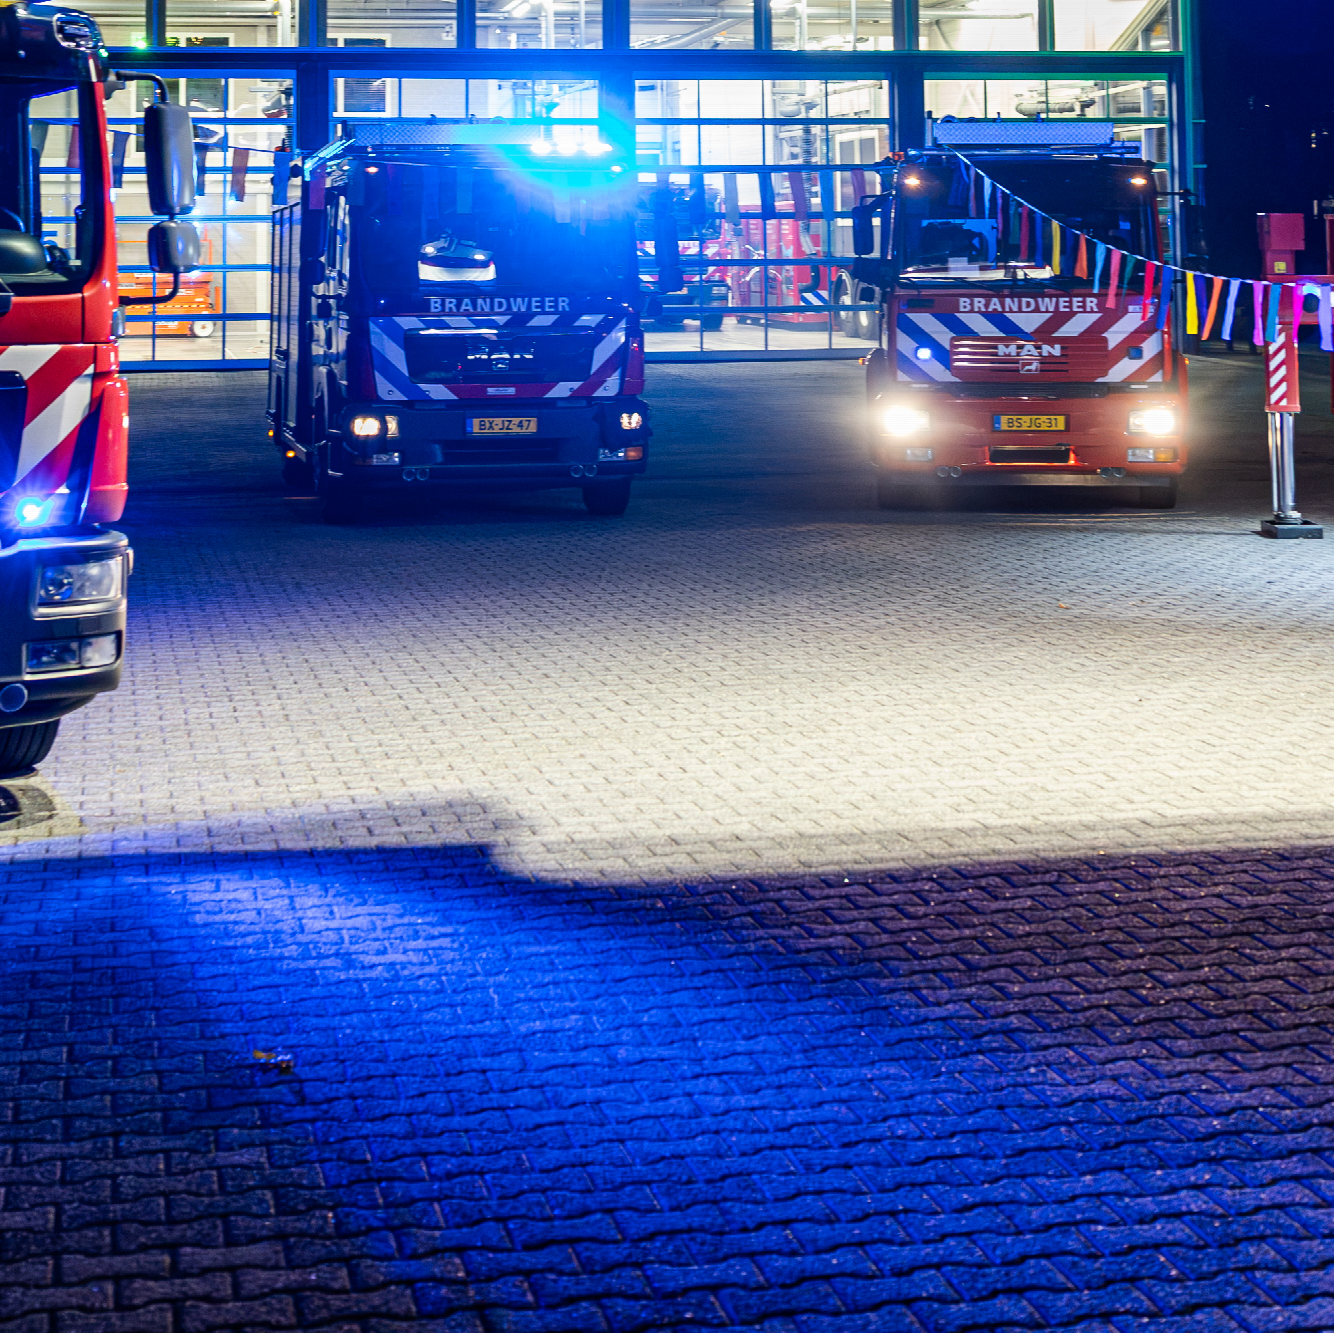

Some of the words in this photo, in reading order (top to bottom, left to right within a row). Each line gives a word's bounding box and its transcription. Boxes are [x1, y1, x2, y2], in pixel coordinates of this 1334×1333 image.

[430, 297, 570, 313] BRANDWEER
[958, 297, 1099, 312] BRANDWEER
[997, 344, 1062, 357] MAN
[478, 419, 533, 431] BX-JZ-47
[1006, 417, 1059, 429] BS-JG-31
